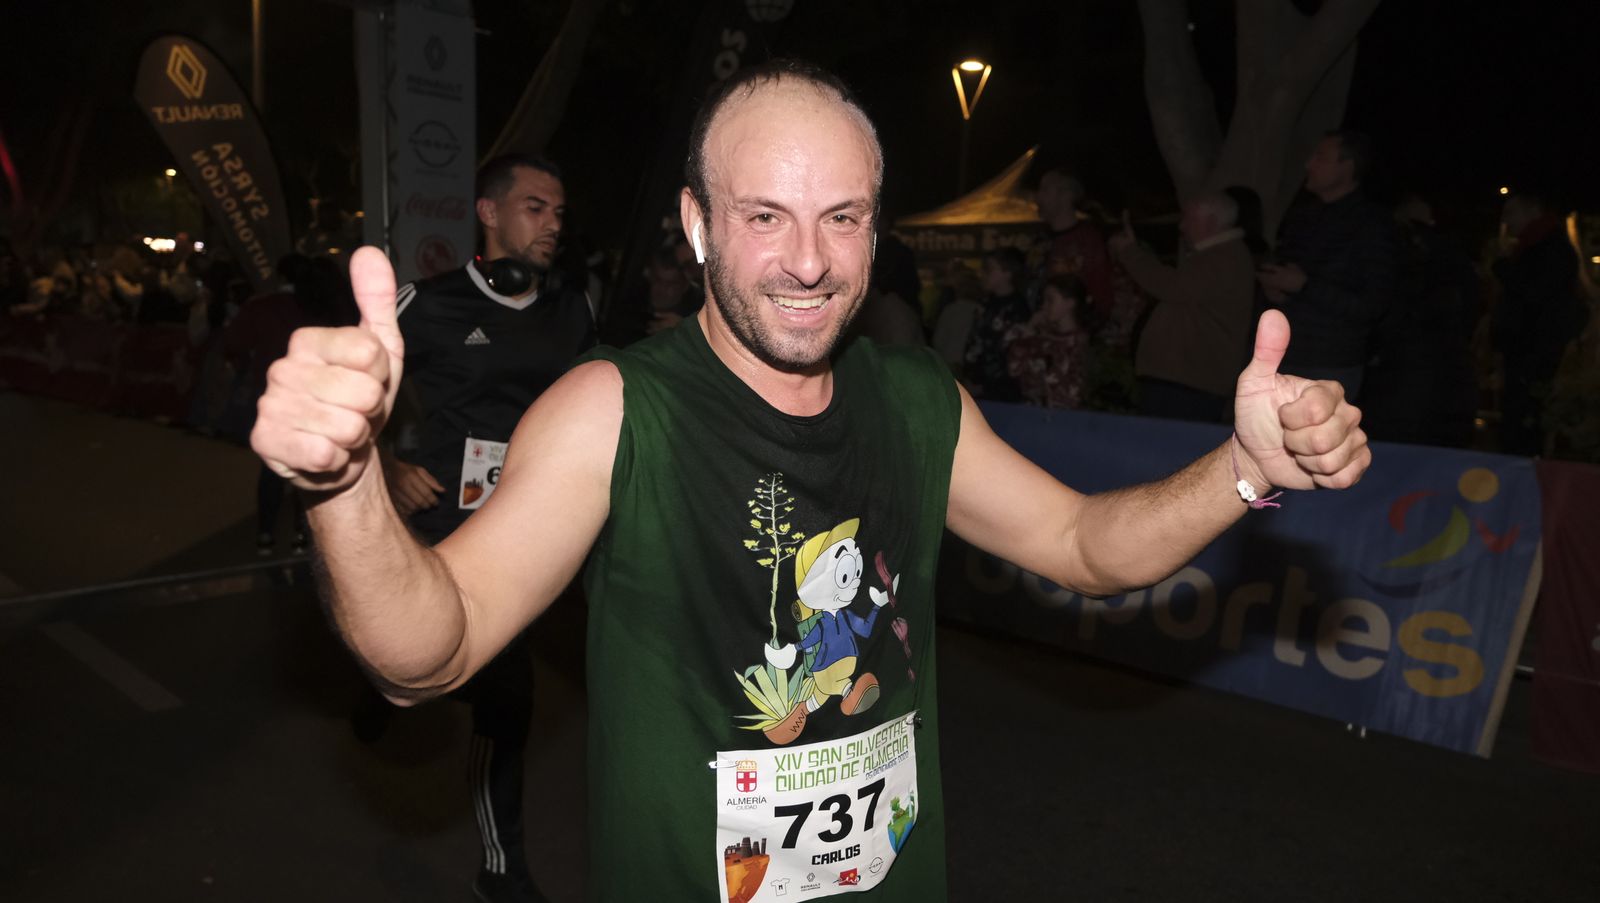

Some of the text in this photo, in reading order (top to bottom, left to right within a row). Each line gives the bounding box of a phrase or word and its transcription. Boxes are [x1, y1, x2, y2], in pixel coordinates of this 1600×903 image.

[774, 753, 803, 773] XIV
[808, 745, 842, 769] SAN
[846, 718, 908, 761] SILVESTRE
[775, 766, 837, 792] CIUDAD
[840, 760, 860, 781] DE
[726, 796, 768, 806] ALMERÍA
[774, 778, 886, 849] 737
[811, 844, 861, 866] CARLOS
